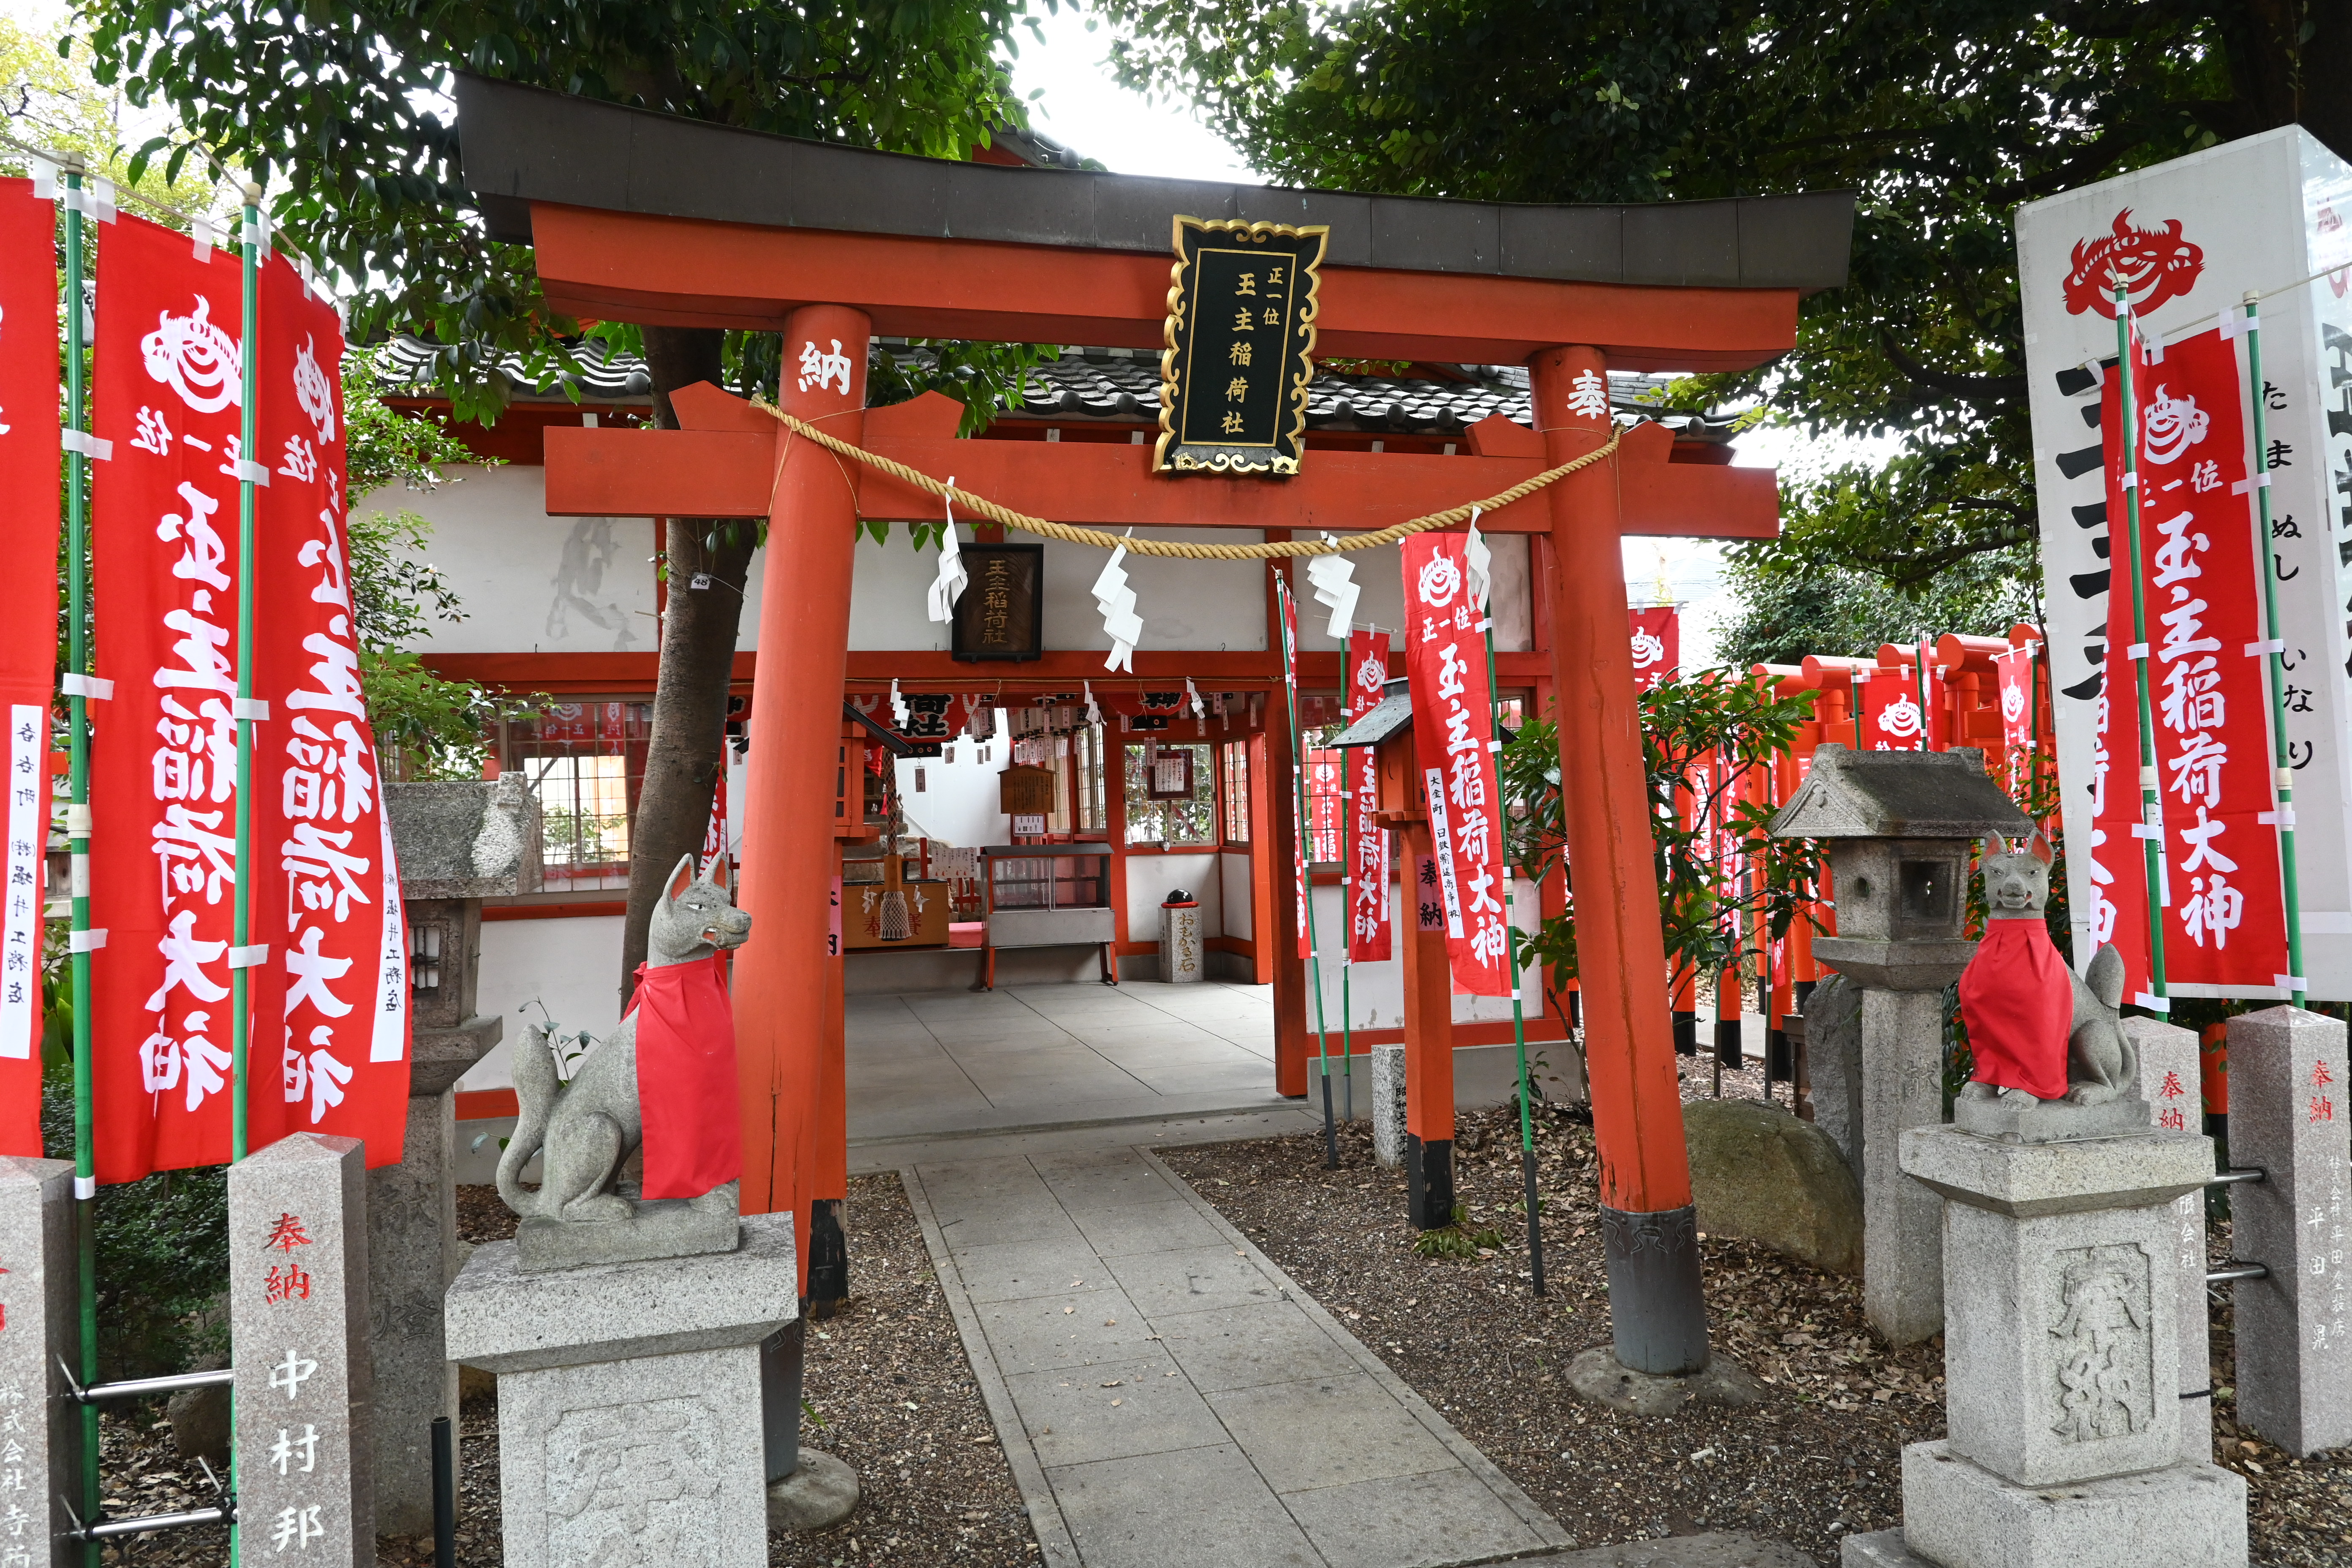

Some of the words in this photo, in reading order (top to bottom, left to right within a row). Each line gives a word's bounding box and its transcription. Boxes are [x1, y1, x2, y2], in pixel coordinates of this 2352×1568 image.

[1263, 267, 1283, 326] 正一位
[798, 339, 851, 395] 納
[1567, 369, 1607, 419] 奉
[1422, 607, 1472, 642] 正一位
[2152, 511, 2244, 950] 玉主稲荷大神
[1430, 776, 1443, 815] 大金町
[1438, 642, 1505, 971] 玉主稲荷大神
[1420, 860, 1443, 927] 奉納
[2159, 1070, 2184, 1131] 奉納
[2308, 1059, 2333, 1123] 奉納
[264, 1212, 313, 1305] 奉納
